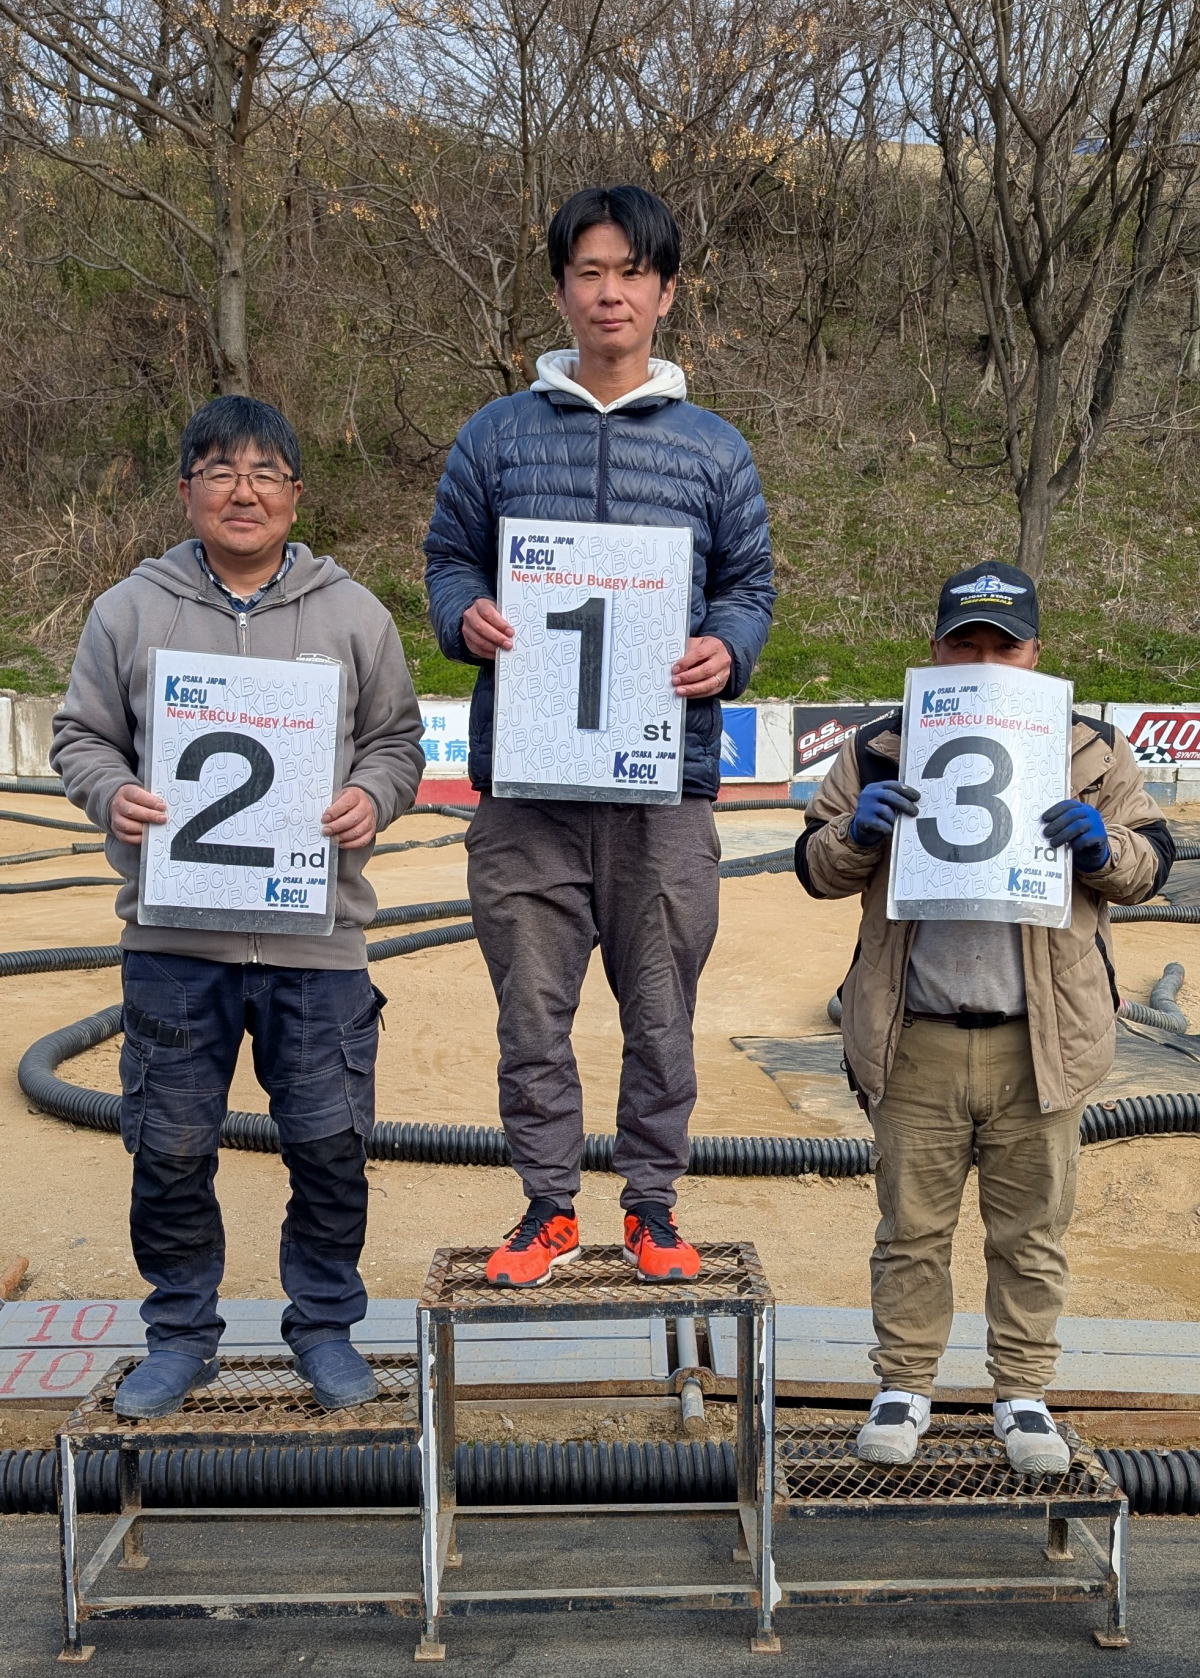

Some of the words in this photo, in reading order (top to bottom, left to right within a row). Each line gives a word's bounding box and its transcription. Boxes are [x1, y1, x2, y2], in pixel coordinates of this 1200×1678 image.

[509, 535, 554, 565] KBCU
[528, 534, 550, 544] OSAKA
[553, 536, 574, 545] JAPAN
[511, 570, 542, 583] New
[546, 572, 583, 585] KBCU
[587, 575, 628, 591] Buggy
[632, 577, 665, 590] Land
[546, 597, 606, 730] 1
[165, 675, 208, 704] KBCU
[182, 675, 203, 685] OSAKA
[206, 677, 227, 686] JAPAN
[922, 689, 961, 715] KBCU
[167, 706, 195, 720] New
[200, 710, 236, 722] KBCU
[240, 713, 280, 730] Buggy
[284, 717, 315, 730] Land
[643, 720, 672, 742] st
[919, 717, 946, 729] New
[949, 714, 983, 727] KBCU
[986, 714, 1022, 731] Buggy
[1025, 721, 1050, 736] Land
[800, 721, 841, 750] O.S.
[802, 726, 857, 761] SPEED
[1135, 719, 1200, 751] KLO
[613, 751, 657, 780] KBCU
[631, 750, 652, 759] OSAKA
[656, 751, 677, 760] JAPAN
[170, 731, 275, 868] 2
[916, 735, 1013, 863] 3
[290, 847, 326, 869] nd
[265, 877, 307, 904] KBCU
[282, 876, 303, 885] OSAKA
[1008, 867, 1046, 895] KBCU
[27, 1303, 118, 1341] 10
[0, 1350, 95, 1393] 10
